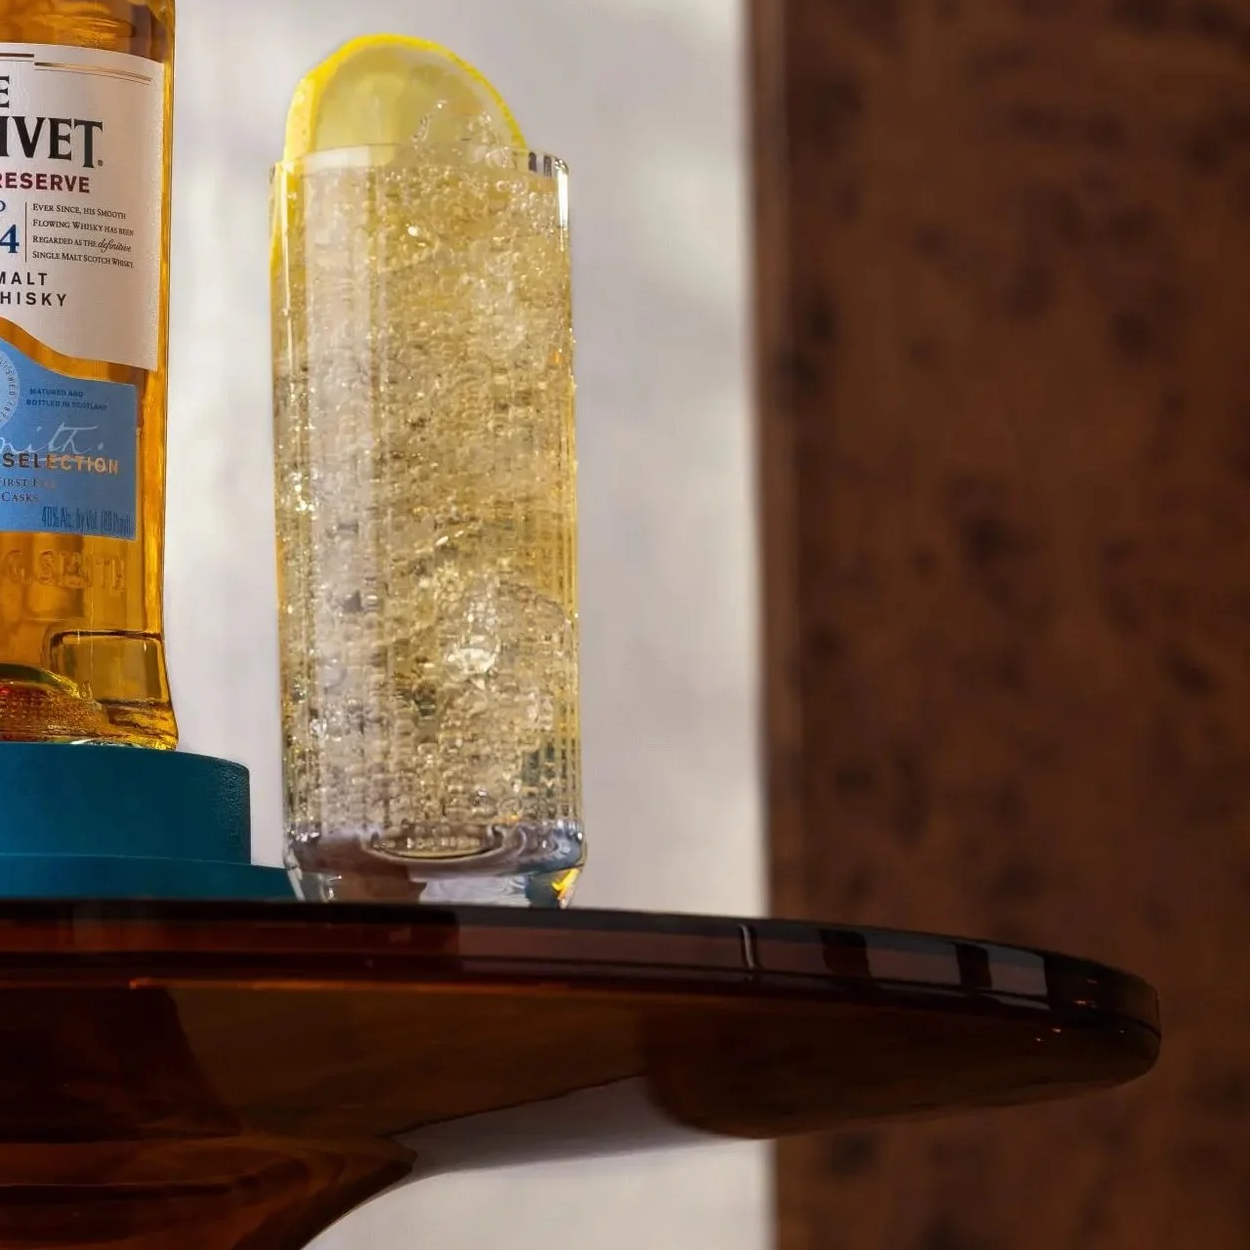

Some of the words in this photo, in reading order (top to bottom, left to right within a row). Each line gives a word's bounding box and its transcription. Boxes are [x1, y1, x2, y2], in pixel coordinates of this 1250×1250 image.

[32, 203, 55, 212] EVER
[56, 204, 83, 215] SINCE,
[83, 207, 97, 216] HIS
[96, 208, 127, 220] SMOOTH
[32, 219, 71, 229] FLOWING
[72, 221, 104, 232] WHISKY
[104, 225, 119, 234] HAS
[32, 235, 74, 246] REGARDED
[73, 238, 84, 246] AS
[83, 239, 98, 248] THE
[97, 237, 133, 254] definitive
[32, 250, 62, 260] SINGLE
[61, 252, 84, 263] MALT
[83, 254, 111, 265] SCOTCH
[2, 453, 119, 474] SELECTION
[1, 492, 40, 503] CASKS
